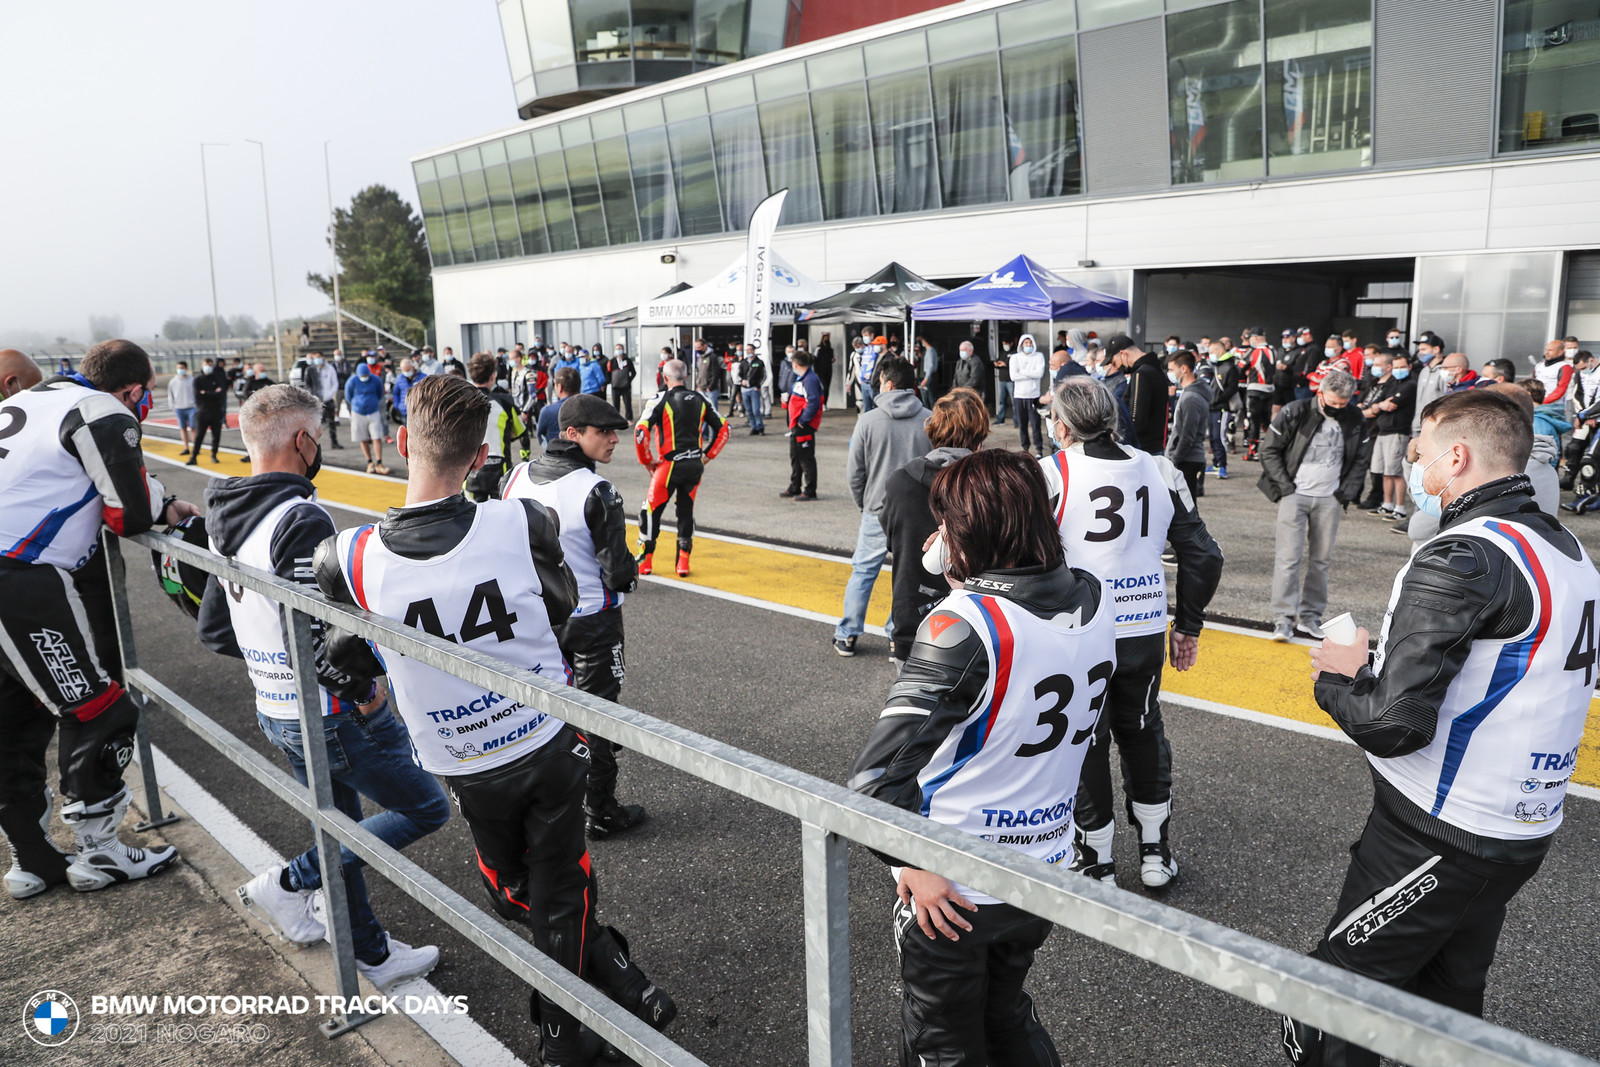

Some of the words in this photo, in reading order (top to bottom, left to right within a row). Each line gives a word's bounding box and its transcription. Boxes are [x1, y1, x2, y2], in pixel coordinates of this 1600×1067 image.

[649, 305, 674, 317] BMW
[676, 303, 736, 316] MOTORRAD
[1084, 485, 1150, 542] 31
[403, 578, 518, 644] 44
[1563, 600, 1600, 687] 4
[29, 633, 81, 702] NESS
[41, 627, 94, 698] ARLEN
[456, 718, 489, 734] BMW
[1014, 660, 1114, 757] 33
[997, 834, 1035, 845] BMW
[1347, 874, 1438, 946] alpinestars
